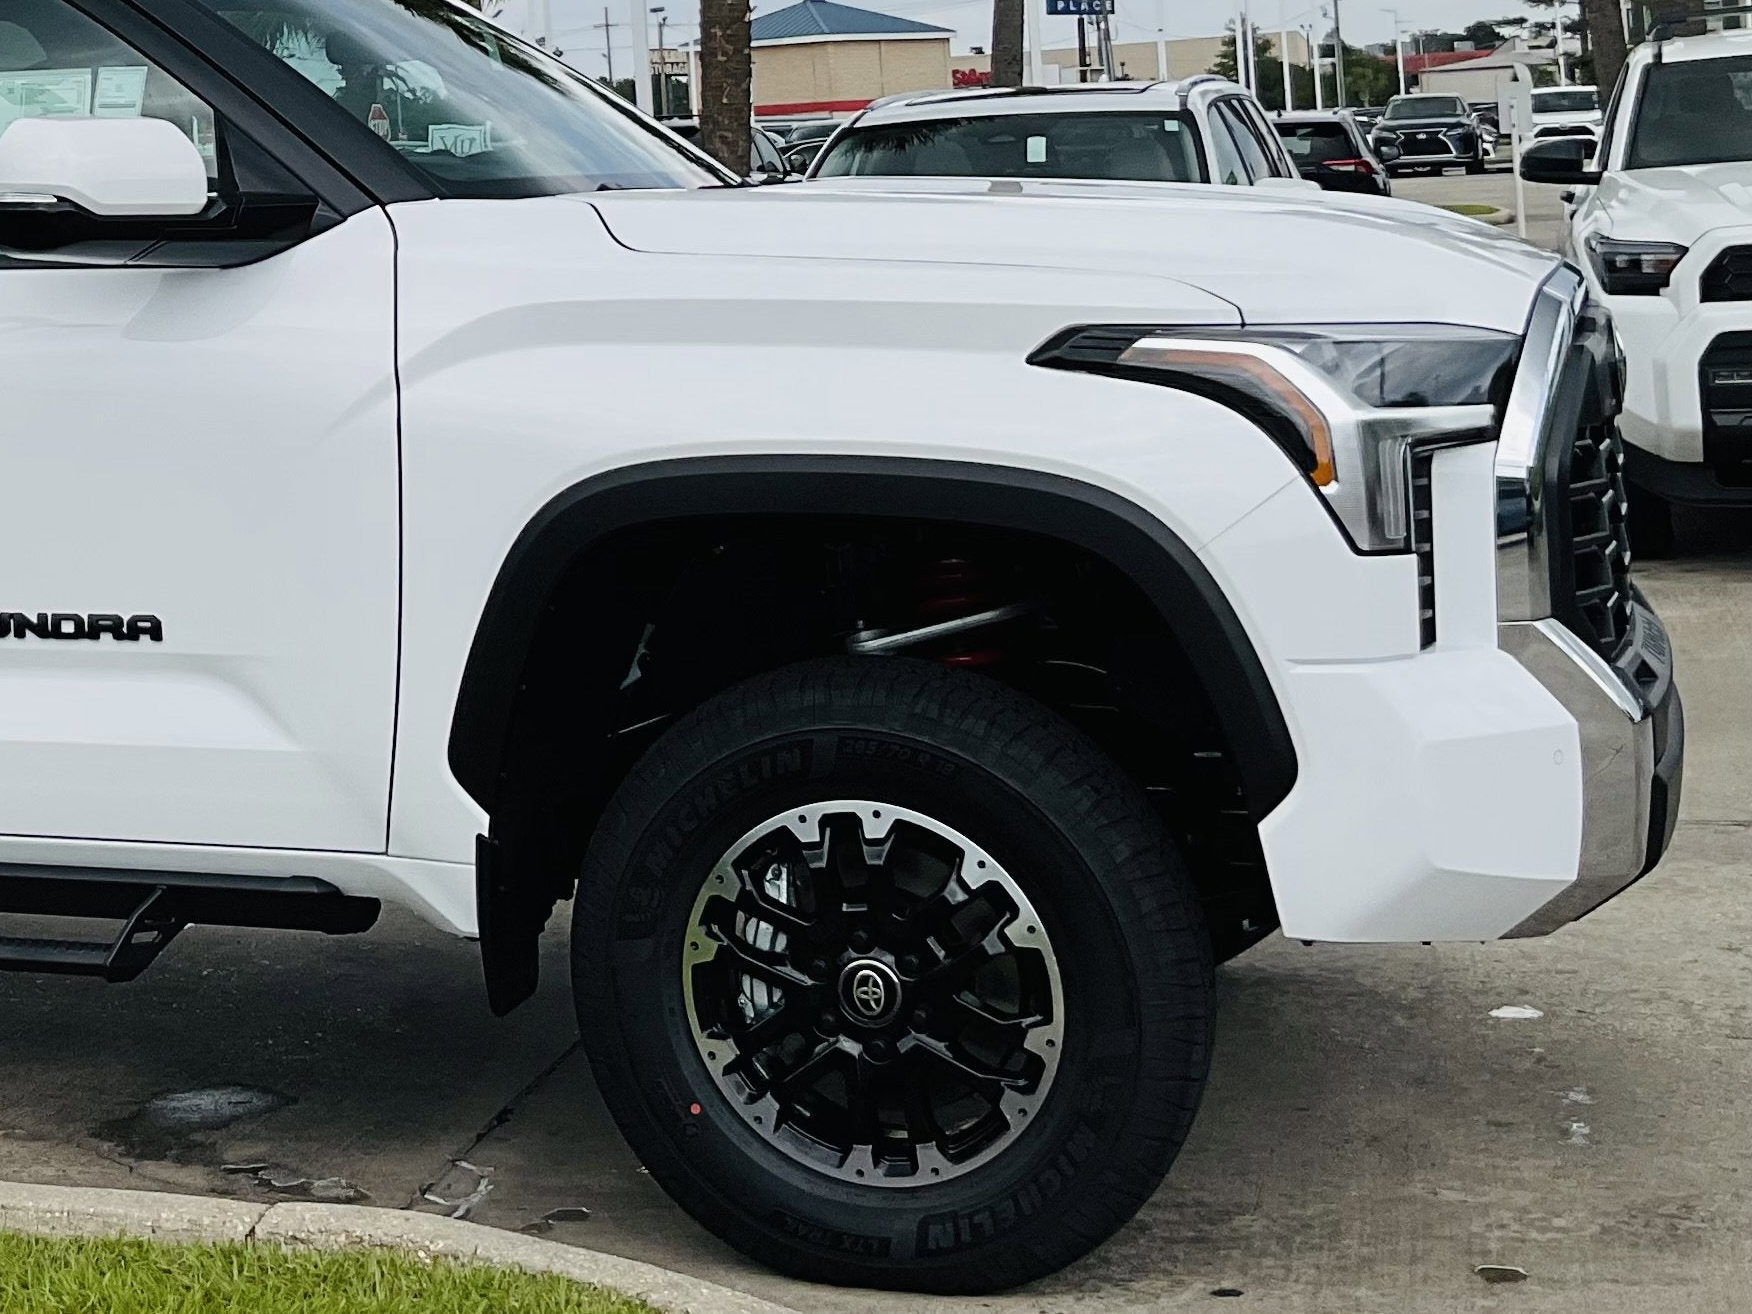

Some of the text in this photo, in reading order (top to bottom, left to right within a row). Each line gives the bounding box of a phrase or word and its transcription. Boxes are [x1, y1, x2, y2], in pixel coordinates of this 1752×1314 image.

[1056, 0, 1112, 11] PLACE
[648, 739, 805, 878] MICHELIN
[927, 1121, 1096, 1251] MICHELIN
